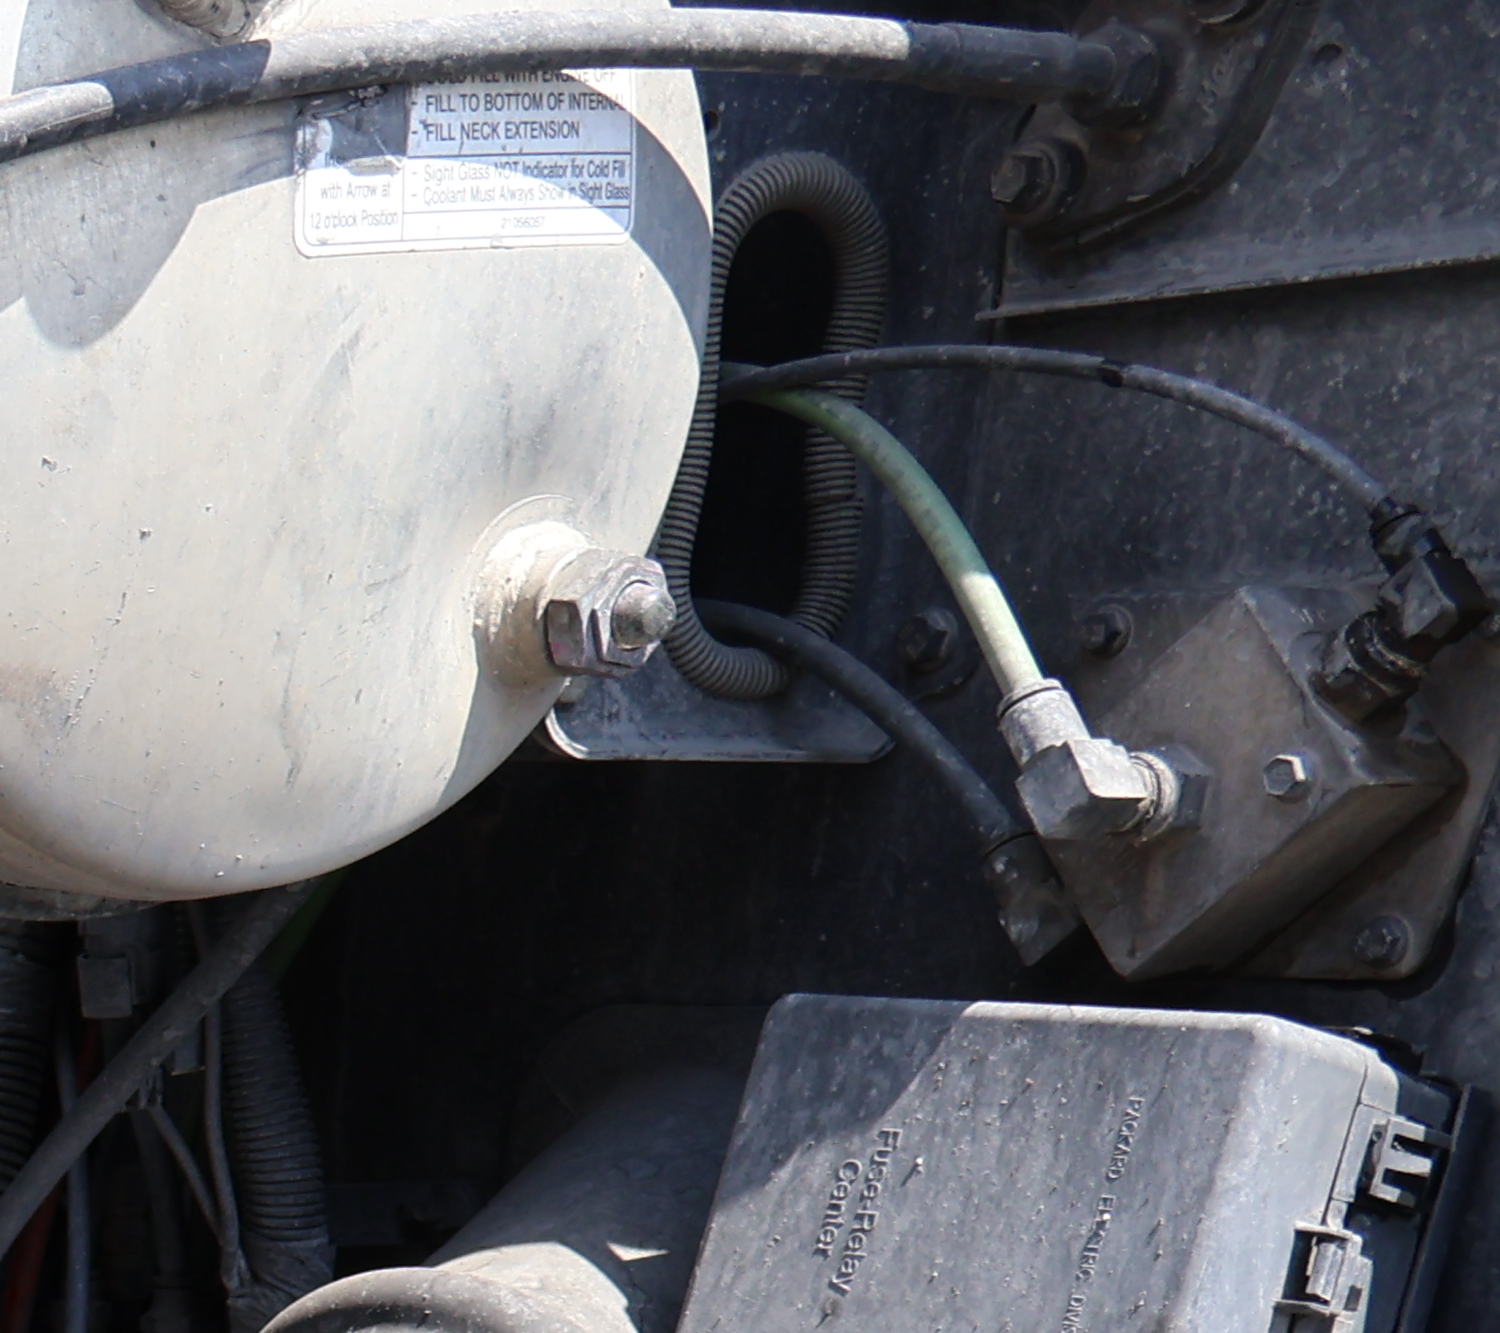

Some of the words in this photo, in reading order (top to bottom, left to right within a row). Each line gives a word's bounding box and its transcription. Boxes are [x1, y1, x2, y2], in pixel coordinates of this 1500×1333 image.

[425, 95, 456, 113] FILL
[459, 93, 479, 112] TO
[485, 92, 543, 112] BOTTOM
[547, 92, 566, 111] OF
[426, 122, 456, 142] FILL
[461, 121, 500, 141] NECK
[504, 120, 580, 140] EXTENSION
[423, 162, 455, 184] Sight
[458, 161, 490, 181] Glass
[494, 160, 519, 180] NOT
[523, 159, 569, 178] Indicator
[571, 159, 584, 177] for
[587, 158, 610, 177] Cold
[612, 158, 627, 177] Fill
[320, 181, 344, 199] with
[346, 181, 377, 198] Arrow
[380, 181, 392, 197] at
[423, 186, 465, 206] Coolant
[468, 185, 496, 203] Must
[500, 184, 535, 206] Always
[580, 181, 603, 205] Sight
[604, 180, 630, 199] Glass
[360, 209, 400, 227] Position
[1104, 1095, 1145, 1184] PACKARD
[811, 1158, 863, 1261] Center
[828, 1127, 904, 1297] Fuse-Relay
